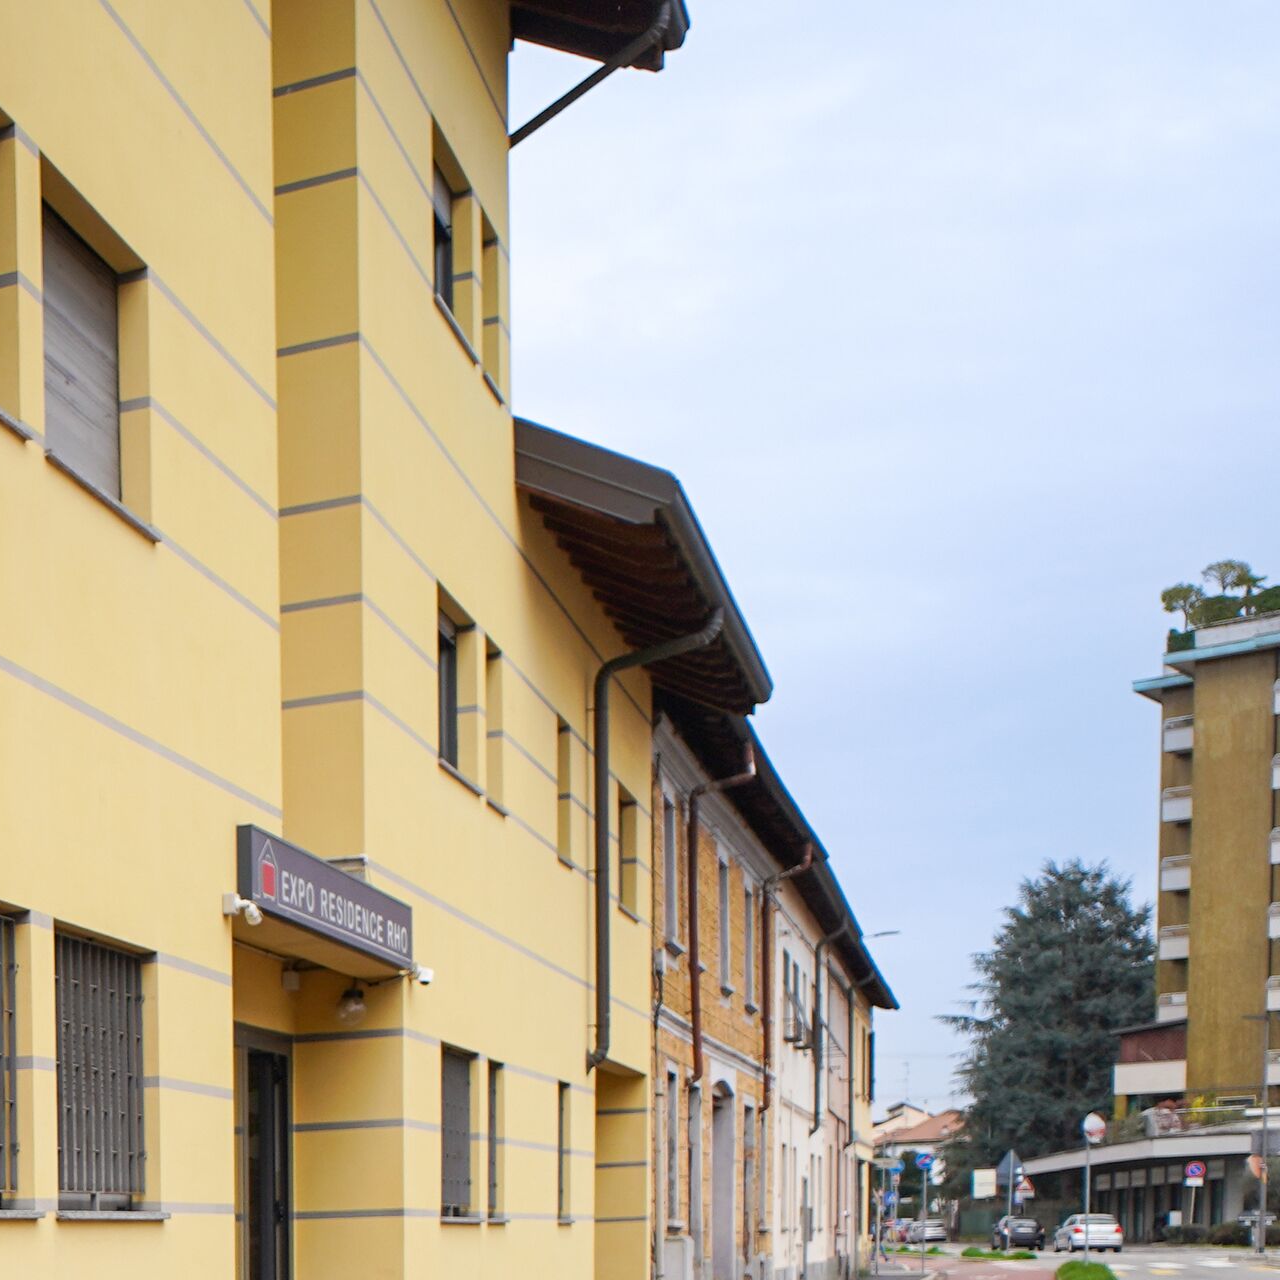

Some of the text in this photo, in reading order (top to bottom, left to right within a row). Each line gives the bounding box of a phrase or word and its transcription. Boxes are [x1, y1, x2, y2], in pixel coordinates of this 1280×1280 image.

[281, 870, 408, 954] EXPO RESIDENCE RHO
